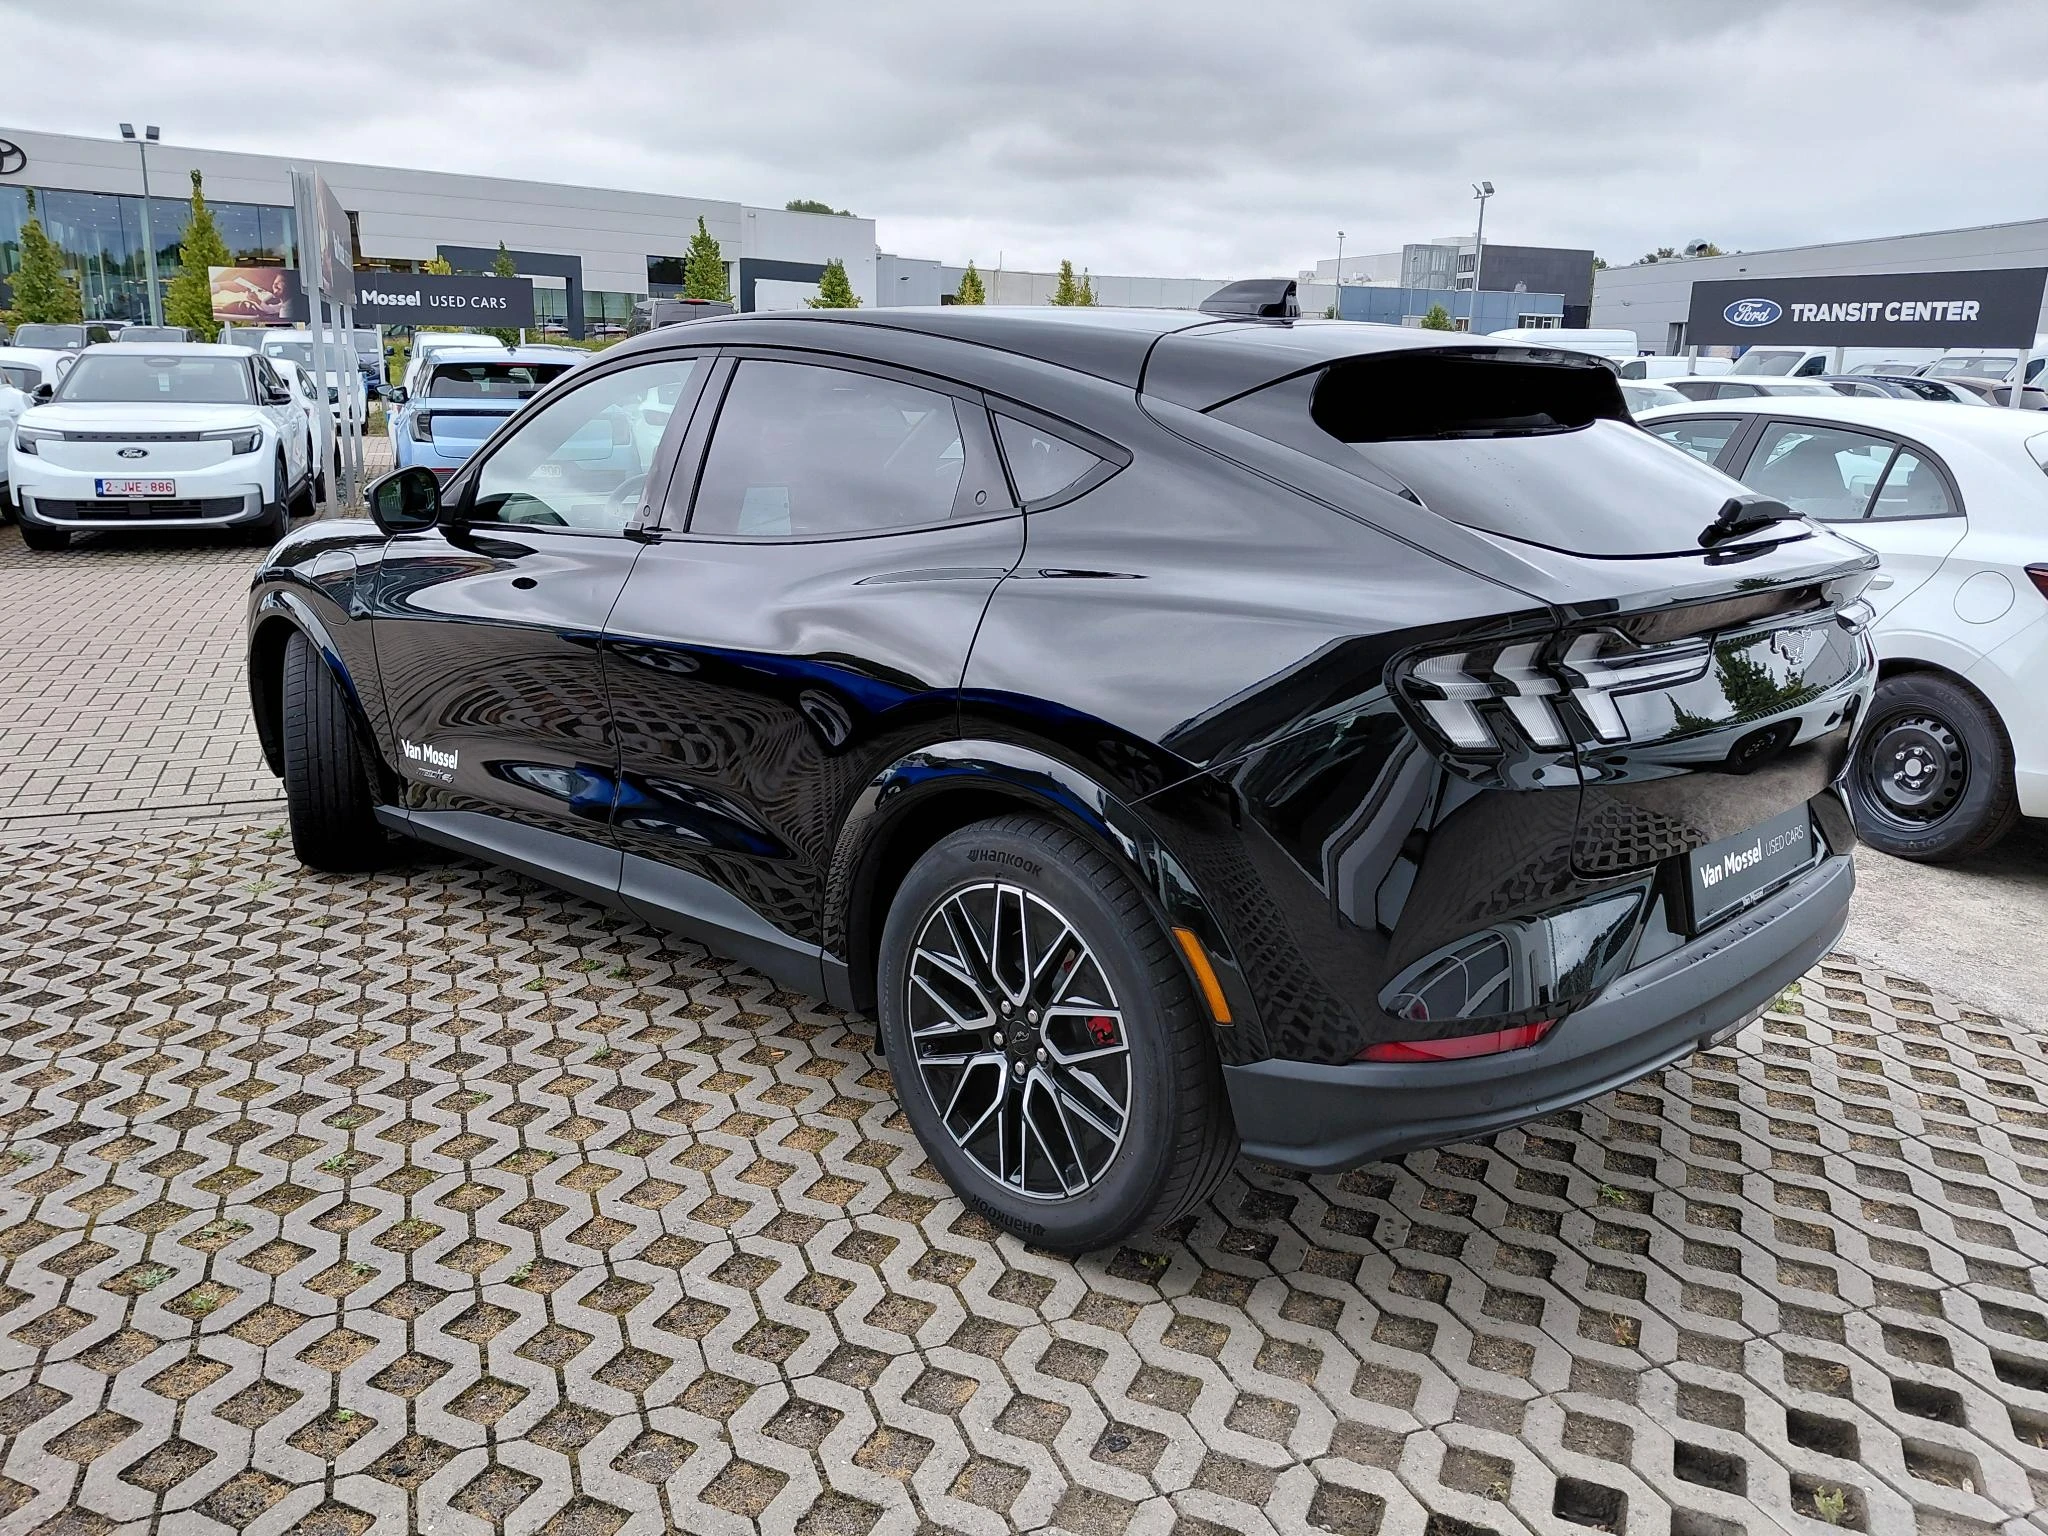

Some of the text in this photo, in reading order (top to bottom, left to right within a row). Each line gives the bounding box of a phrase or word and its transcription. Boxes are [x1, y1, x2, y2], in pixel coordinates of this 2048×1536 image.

[361, 289, 421, 307] Mossel
[429, 295, 465, 308] USED
[470, 296, 507, 309] CARS
[1733, 300, 1981, 323] Ford TRANSIT CENTER
[400, 738, 459, 770] Van Mossel
[1699, 824, 1804, 889] Van Mossel USED CARS
